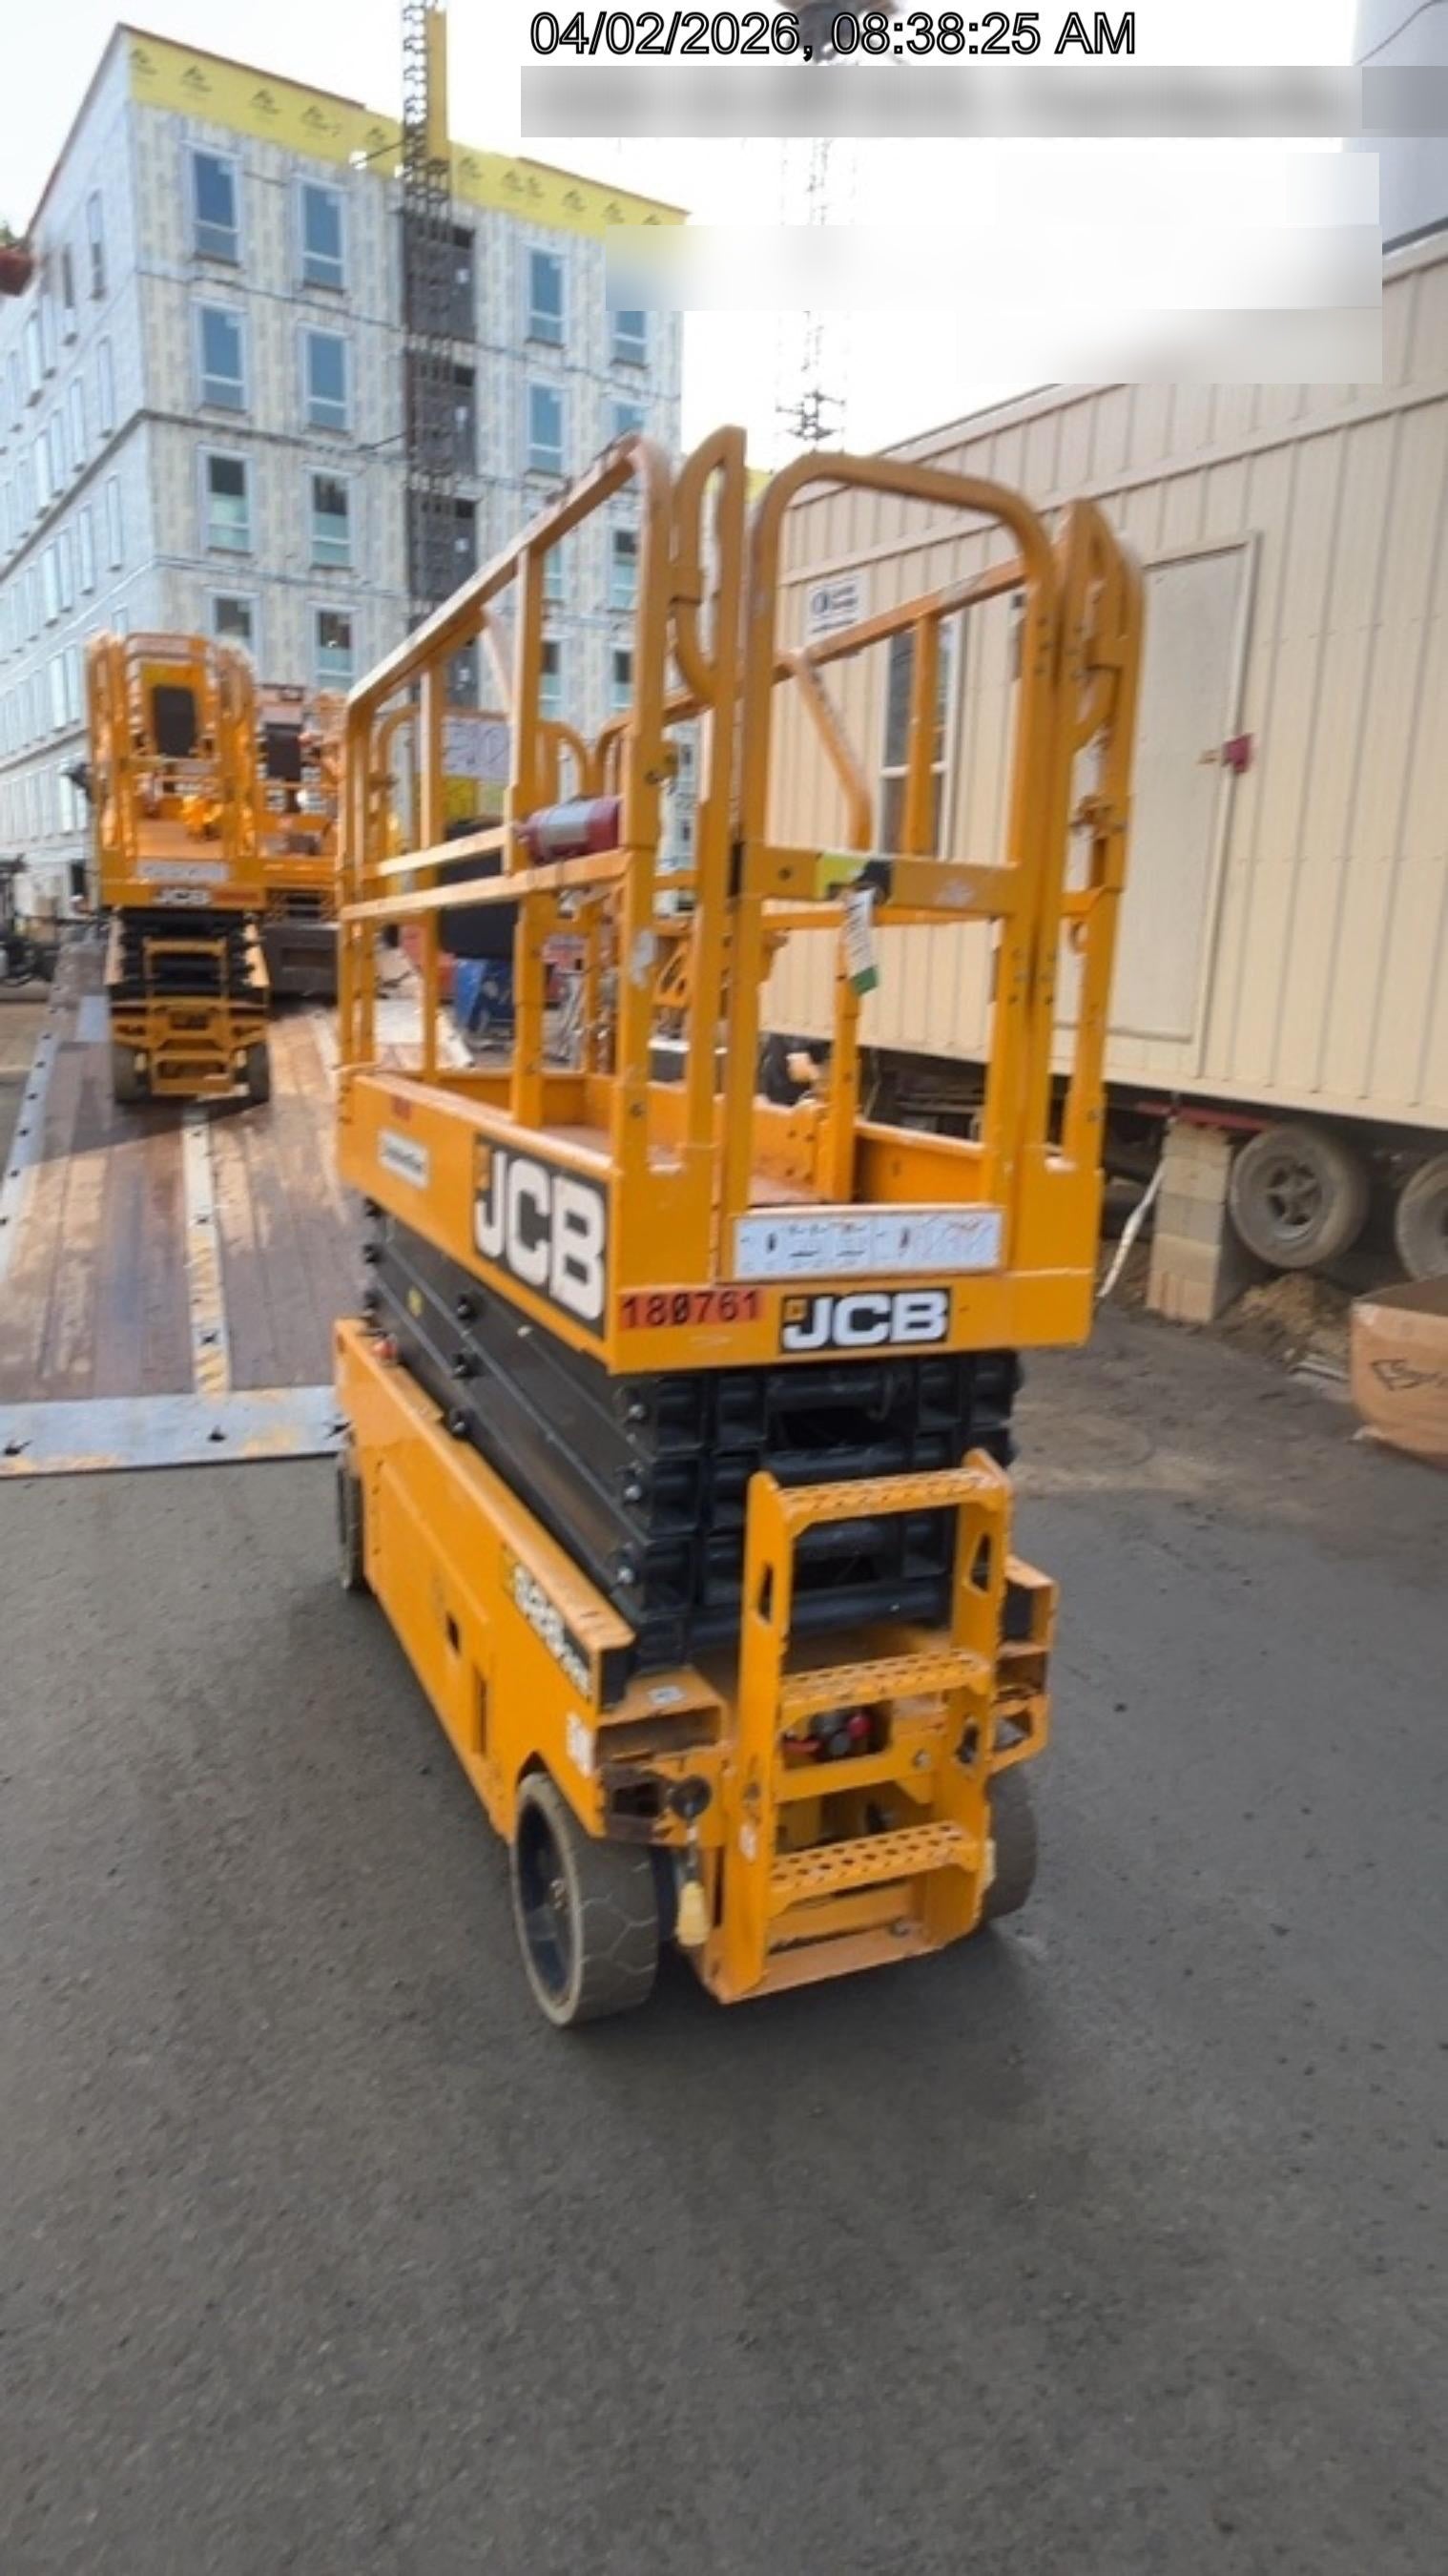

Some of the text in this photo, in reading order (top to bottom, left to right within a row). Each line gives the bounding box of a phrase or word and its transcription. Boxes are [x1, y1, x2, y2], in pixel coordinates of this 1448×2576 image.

[474, 1151, 605, 1320] JCB
[622, 1290, 760, 1329] 180761
[783, 1290, 948, 1350] JCB
